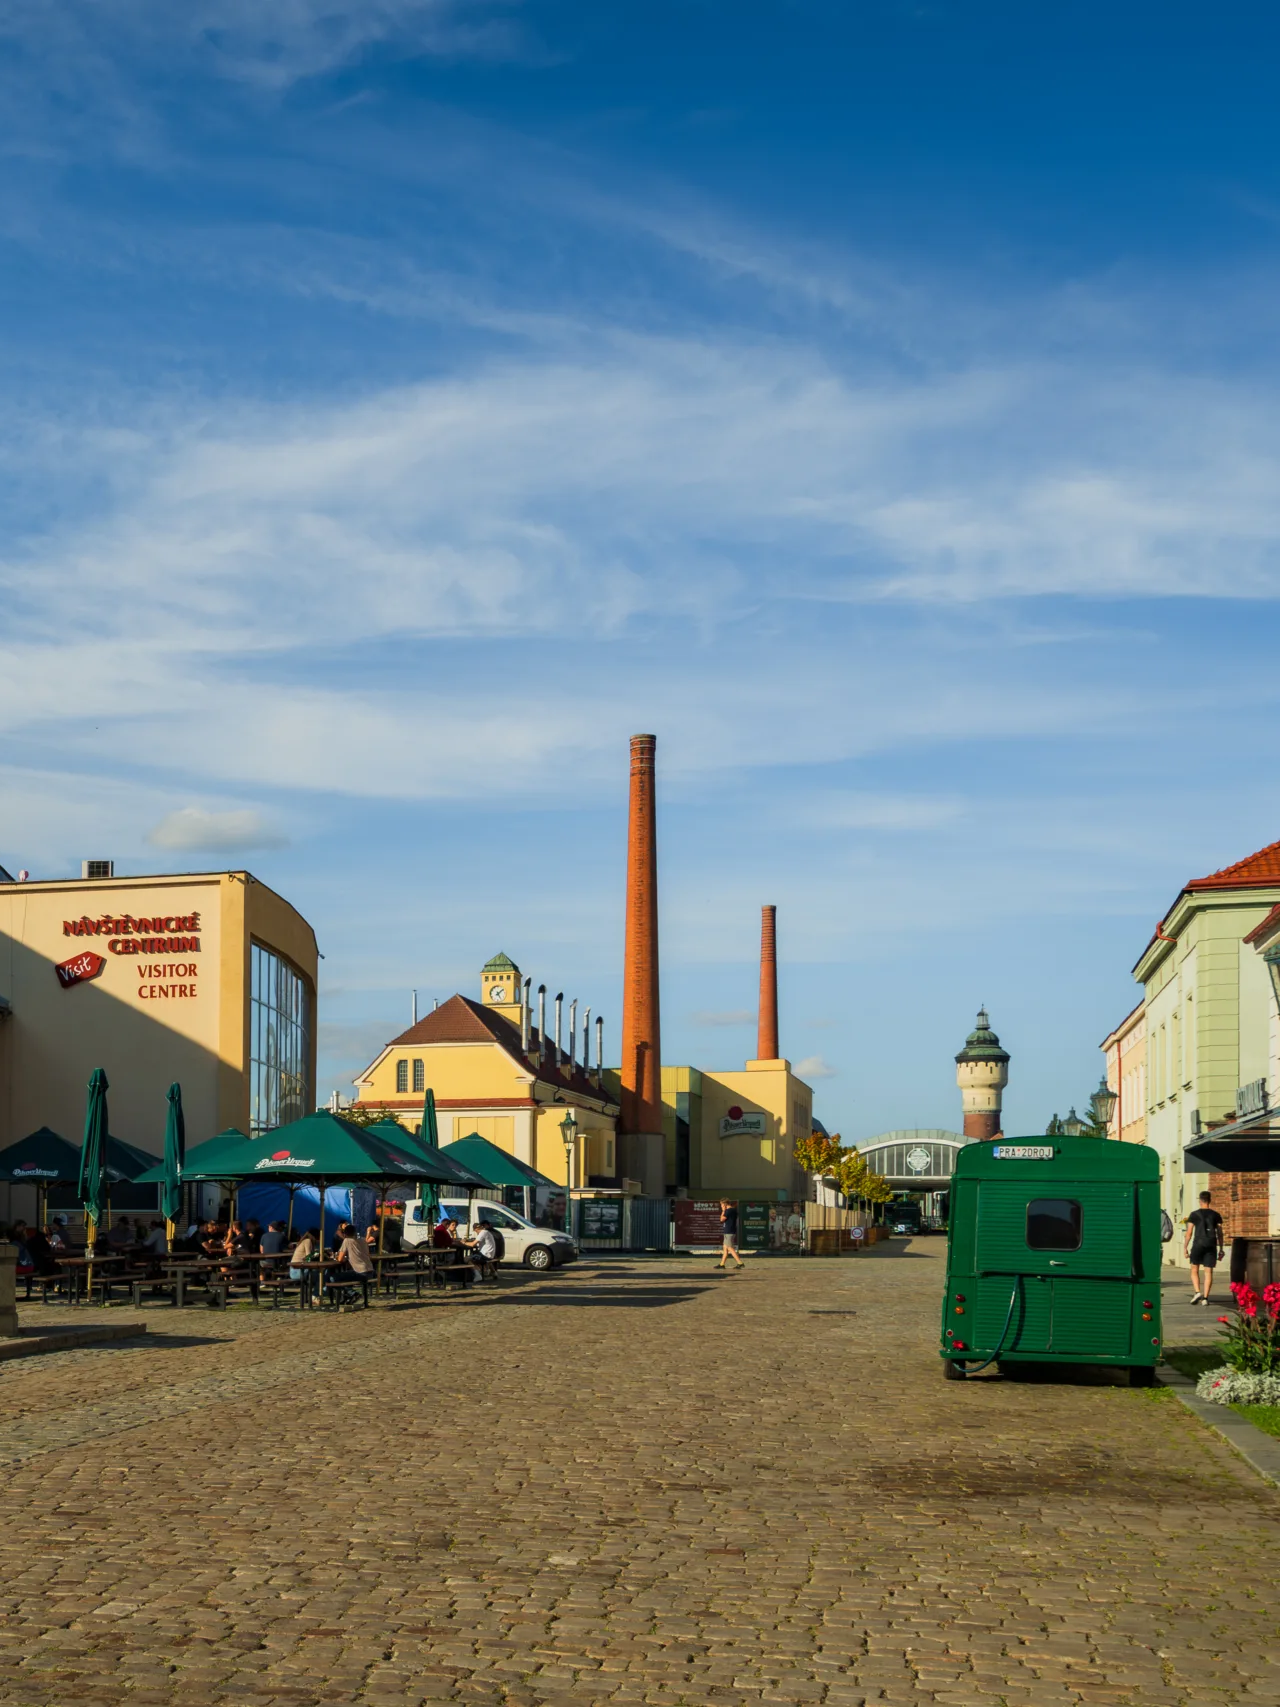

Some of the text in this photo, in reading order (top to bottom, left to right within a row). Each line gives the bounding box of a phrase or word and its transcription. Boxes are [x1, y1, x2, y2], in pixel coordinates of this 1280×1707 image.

[62, 911, 200, 936] NÁVŠTĚVNICKÉ
[108, 936, 199, 954] CENTRUM
[59, 956, 91, 981] Visit
[137, 963, 198, 978] VISITOR
[138, 984, 197, 998] CENTRE
[999, 1148, 1016, 1157] PRA
[254, 1157, 315, 1169] Pilsner Urquell
